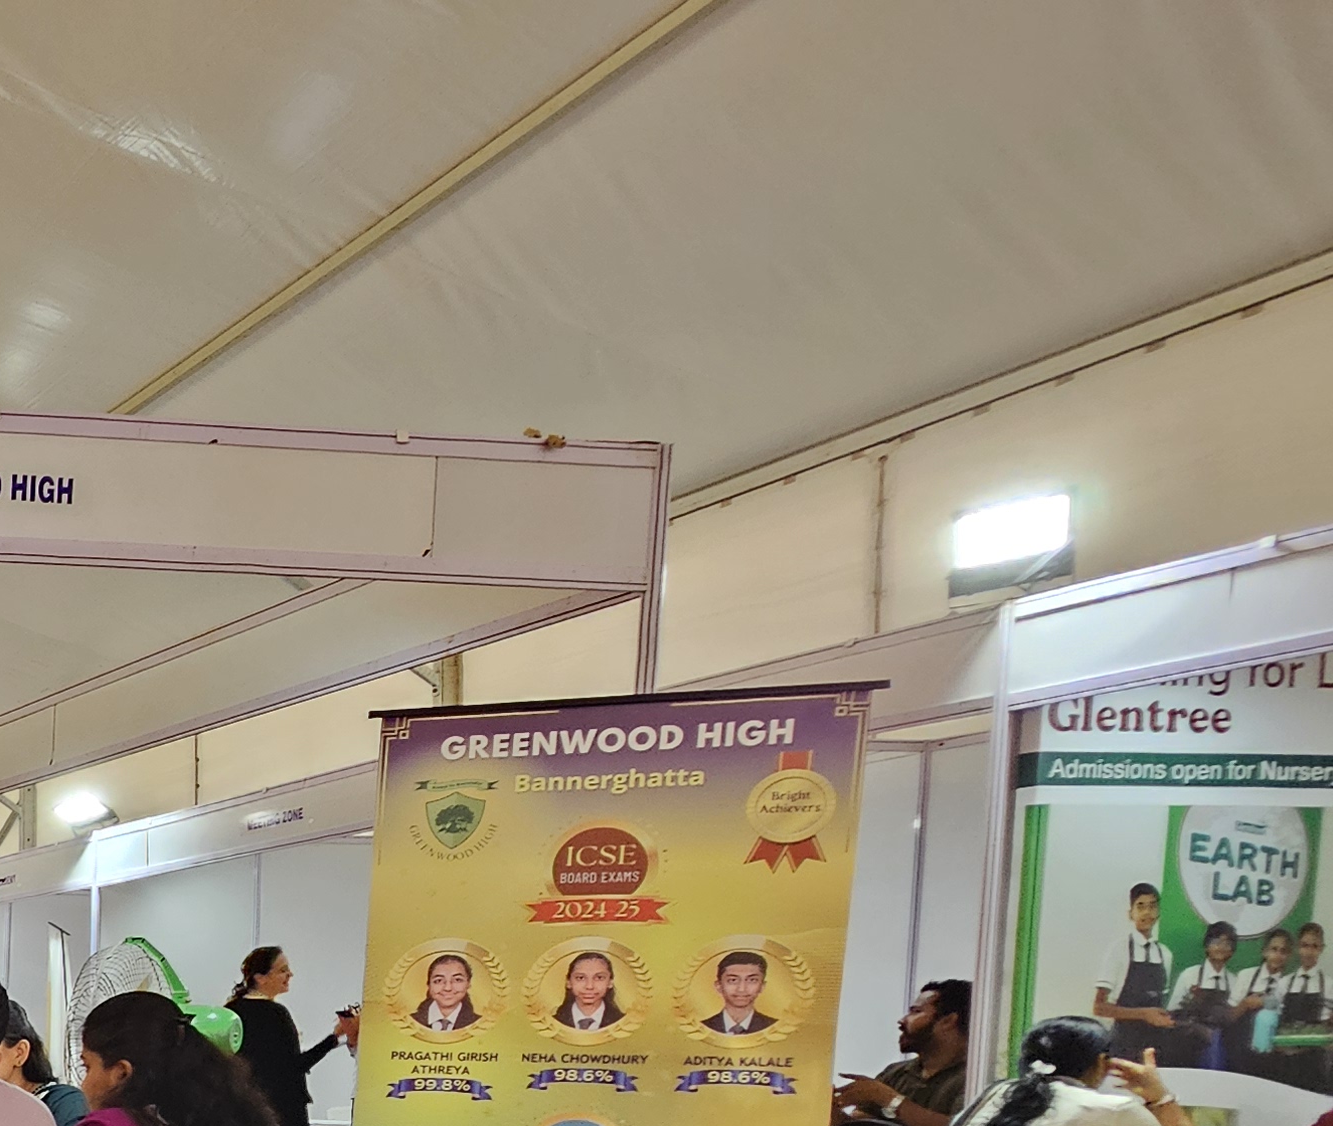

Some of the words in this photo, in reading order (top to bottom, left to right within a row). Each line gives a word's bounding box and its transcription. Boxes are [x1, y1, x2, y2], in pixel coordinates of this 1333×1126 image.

[10, 474, 74, 505] HIGH
[1048, 696, 1232, 733] Glentree
[440, 725, 683, 760] GREENWOOD
[696, 718, 795, 748] HIGH
[1049, 758, 1167, 780] Admissions
[1171, 763, 1222, 784] open
[1226, 760, 1256, 779] for
[1259, 761, 1333, 785] Nurser
[514, 768, 705, 795] Bannerghatta
[771, 790, 811, 802] Bright
[282, 807, 303, 823] ZONE
[759, 803, 821, 813] Achievers
[565, 843, 637, 867] ICSE
[1189, 832, 1300, 879] EARTH
[559, 871, 597, 884] BOARD
[601, 870, 640, 883] EXAMS
[1212, 871, 1276, 906] LAB
[391, 1051, 452, 1061] PRAGATHI
[457, 1052, 498, 1062] GIRISH
[521, 1053, 556, 1063] NEHA
[561, 1053, 648, 1065] CHOWDHURY
[683, 1056, 734, 1067] ADITYA
[739, 1057, 794, 1068] KALALE
[411, 1065, 470, 1075] ATHREYA
[554, 1070, 613, 1083] 98.6%
[707, 1071, 771, 1084] 98.6%
[414, 1079, 471, 1092] 99.8%
